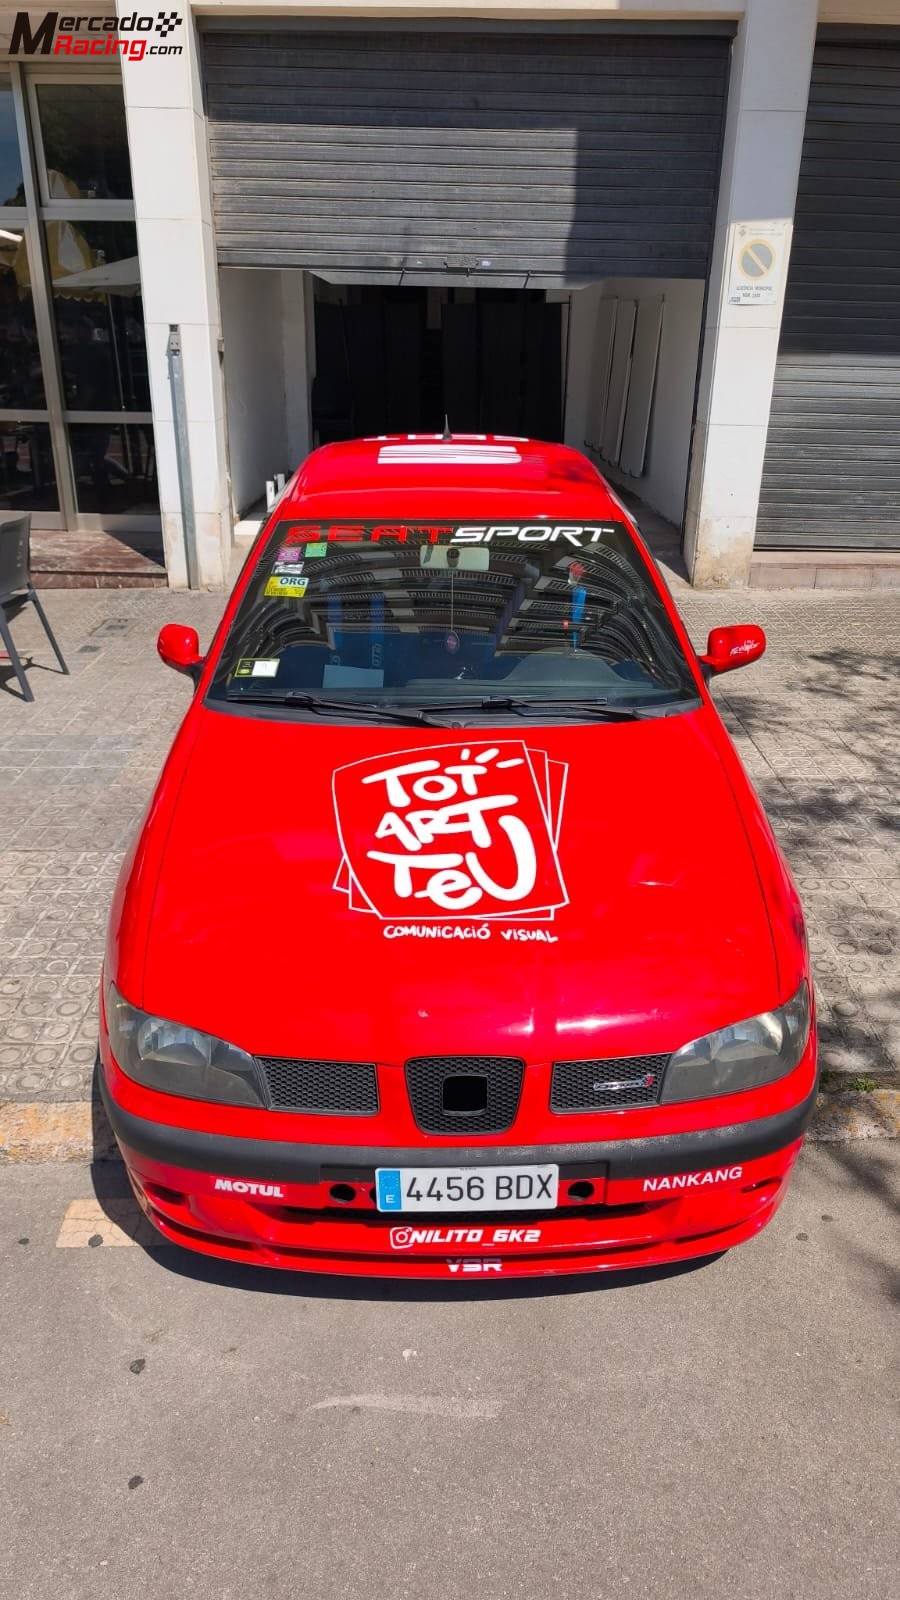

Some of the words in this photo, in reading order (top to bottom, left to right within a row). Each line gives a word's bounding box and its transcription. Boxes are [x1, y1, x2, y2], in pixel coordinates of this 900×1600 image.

[279, 577, 306, 586] ORG
[375, 794, 519, 851] ART
[214, 1178, 285, 1198] MOTUL
[385, 1194, 396, 1204] E
[406, 1176, 485, 1202] 4456
[495, 1173, 553, 1200] BDX
[642, 1165, 744, 1192] NANKANG
[446, 1258, 503, 1273] VSR
